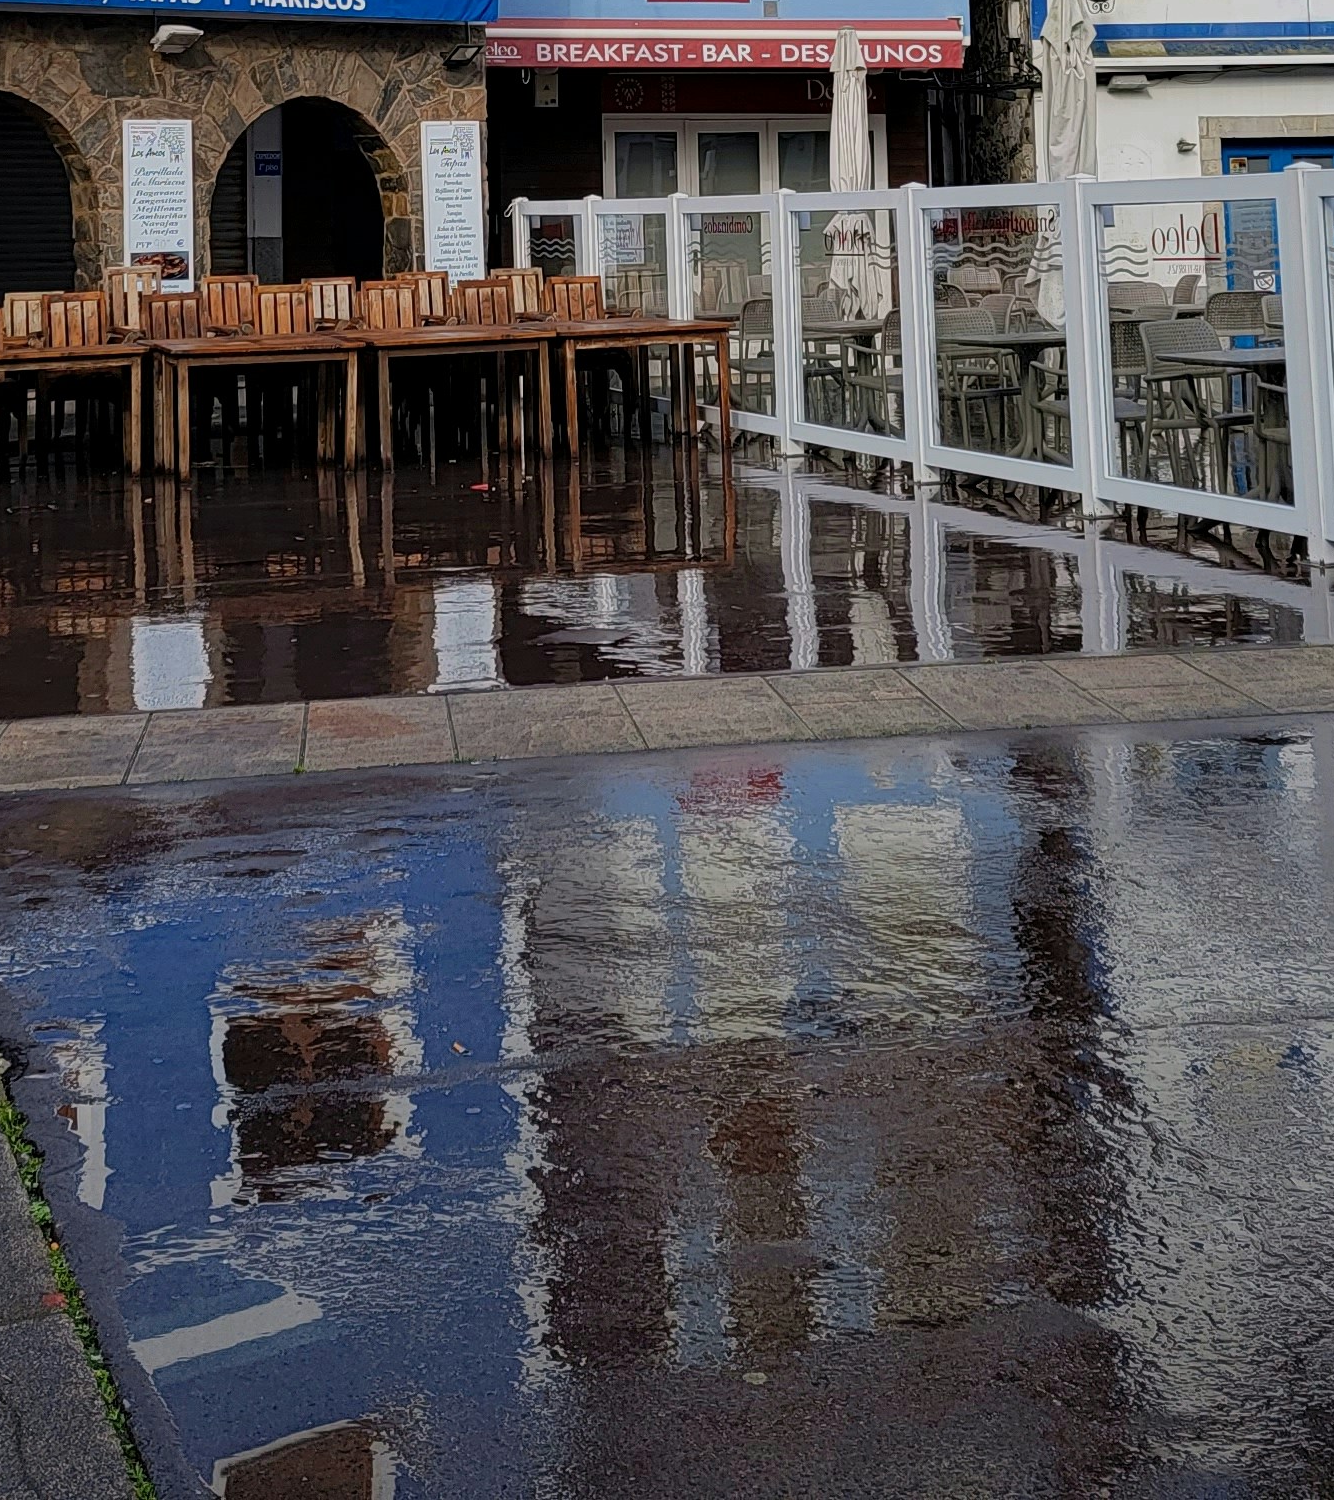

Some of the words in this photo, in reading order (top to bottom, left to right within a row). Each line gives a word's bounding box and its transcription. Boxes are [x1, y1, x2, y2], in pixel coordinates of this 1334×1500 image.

[485, 41, 518, 56] eleo
[535, 43, 684, 63] BREAKFAST
[702, 43, 754, 63] BAR
[780, 43, 943, 64] DESUNOS
[130, 147, 144, 158] Los
[130, 177, 142, 186] de
[135, 189, 184, 198] Bogavante
[135, 205, 184, 213] Mejillones
[131, 213, 187, 221] Zamburiñas
[140, 220, 179, 228] Navajas
[140, 228, 179, 236] Almejas
[135, 241, 153, 249] PVP
